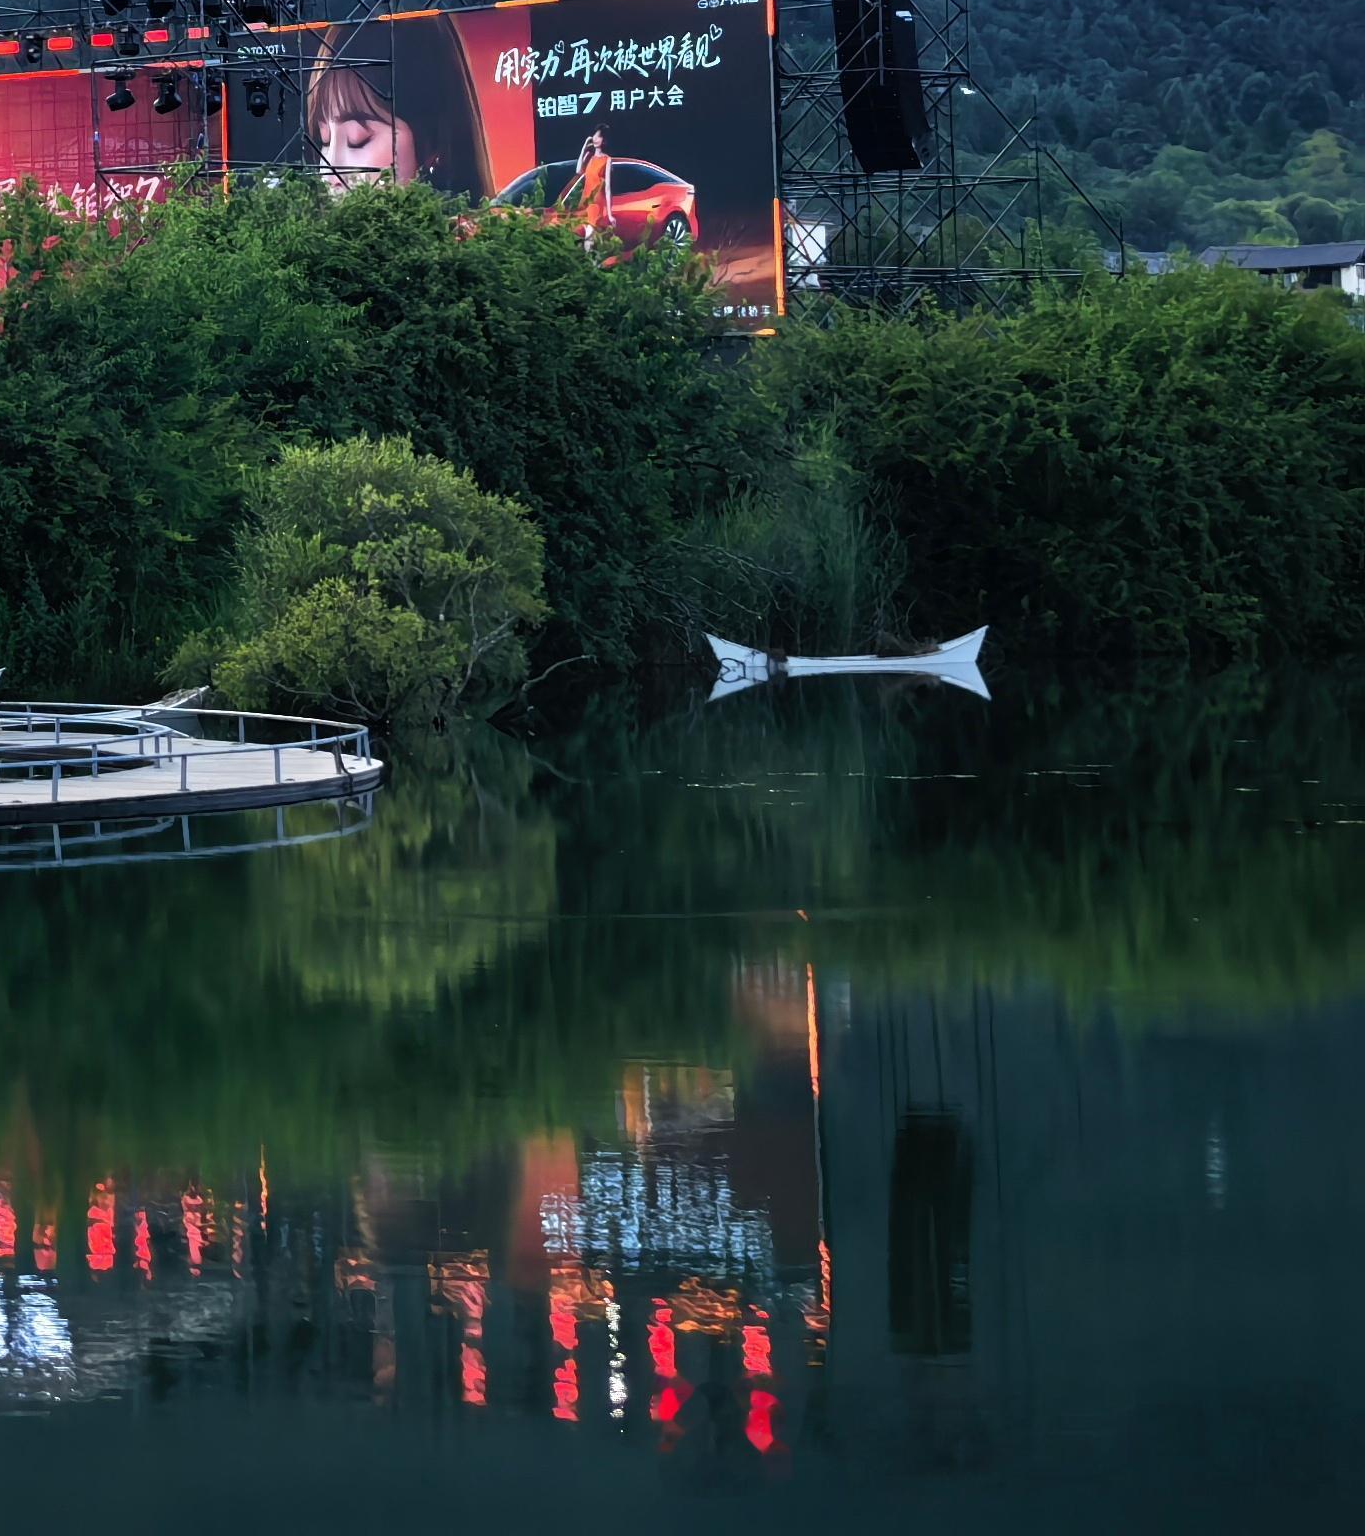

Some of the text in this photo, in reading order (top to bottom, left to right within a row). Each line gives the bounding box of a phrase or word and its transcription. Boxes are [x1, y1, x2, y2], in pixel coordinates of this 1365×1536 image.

[537, 84, 685, 117] 铂智7 用户大会
